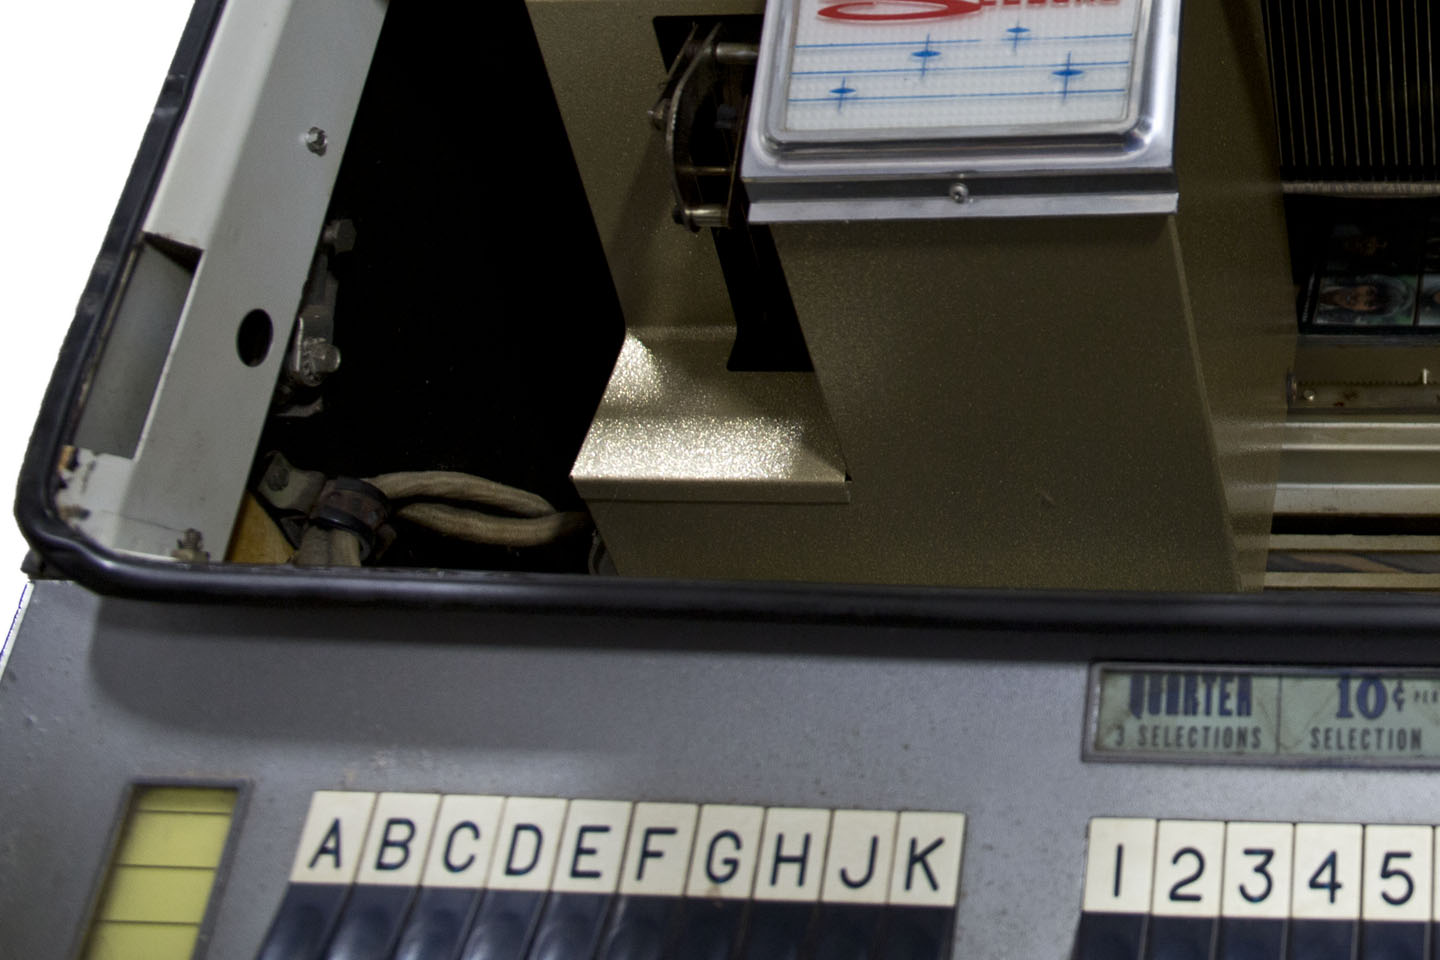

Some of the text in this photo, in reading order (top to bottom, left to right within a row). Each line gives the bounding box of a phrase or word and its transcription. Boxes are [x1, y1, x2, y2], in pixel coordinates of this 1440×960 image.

[1137, 725, 1262, 749] SELECTIONS
[1310, 726, 1422, 752] SELECTION
[309, 817, 945, 891] A B C D E F G H J K
[1168, 847, 1205, 902] 2
[1239, 849, 1275, 903] 3
[1308, 851, 1342, 904] 4
[1380, 852, 1414, 905] 5
